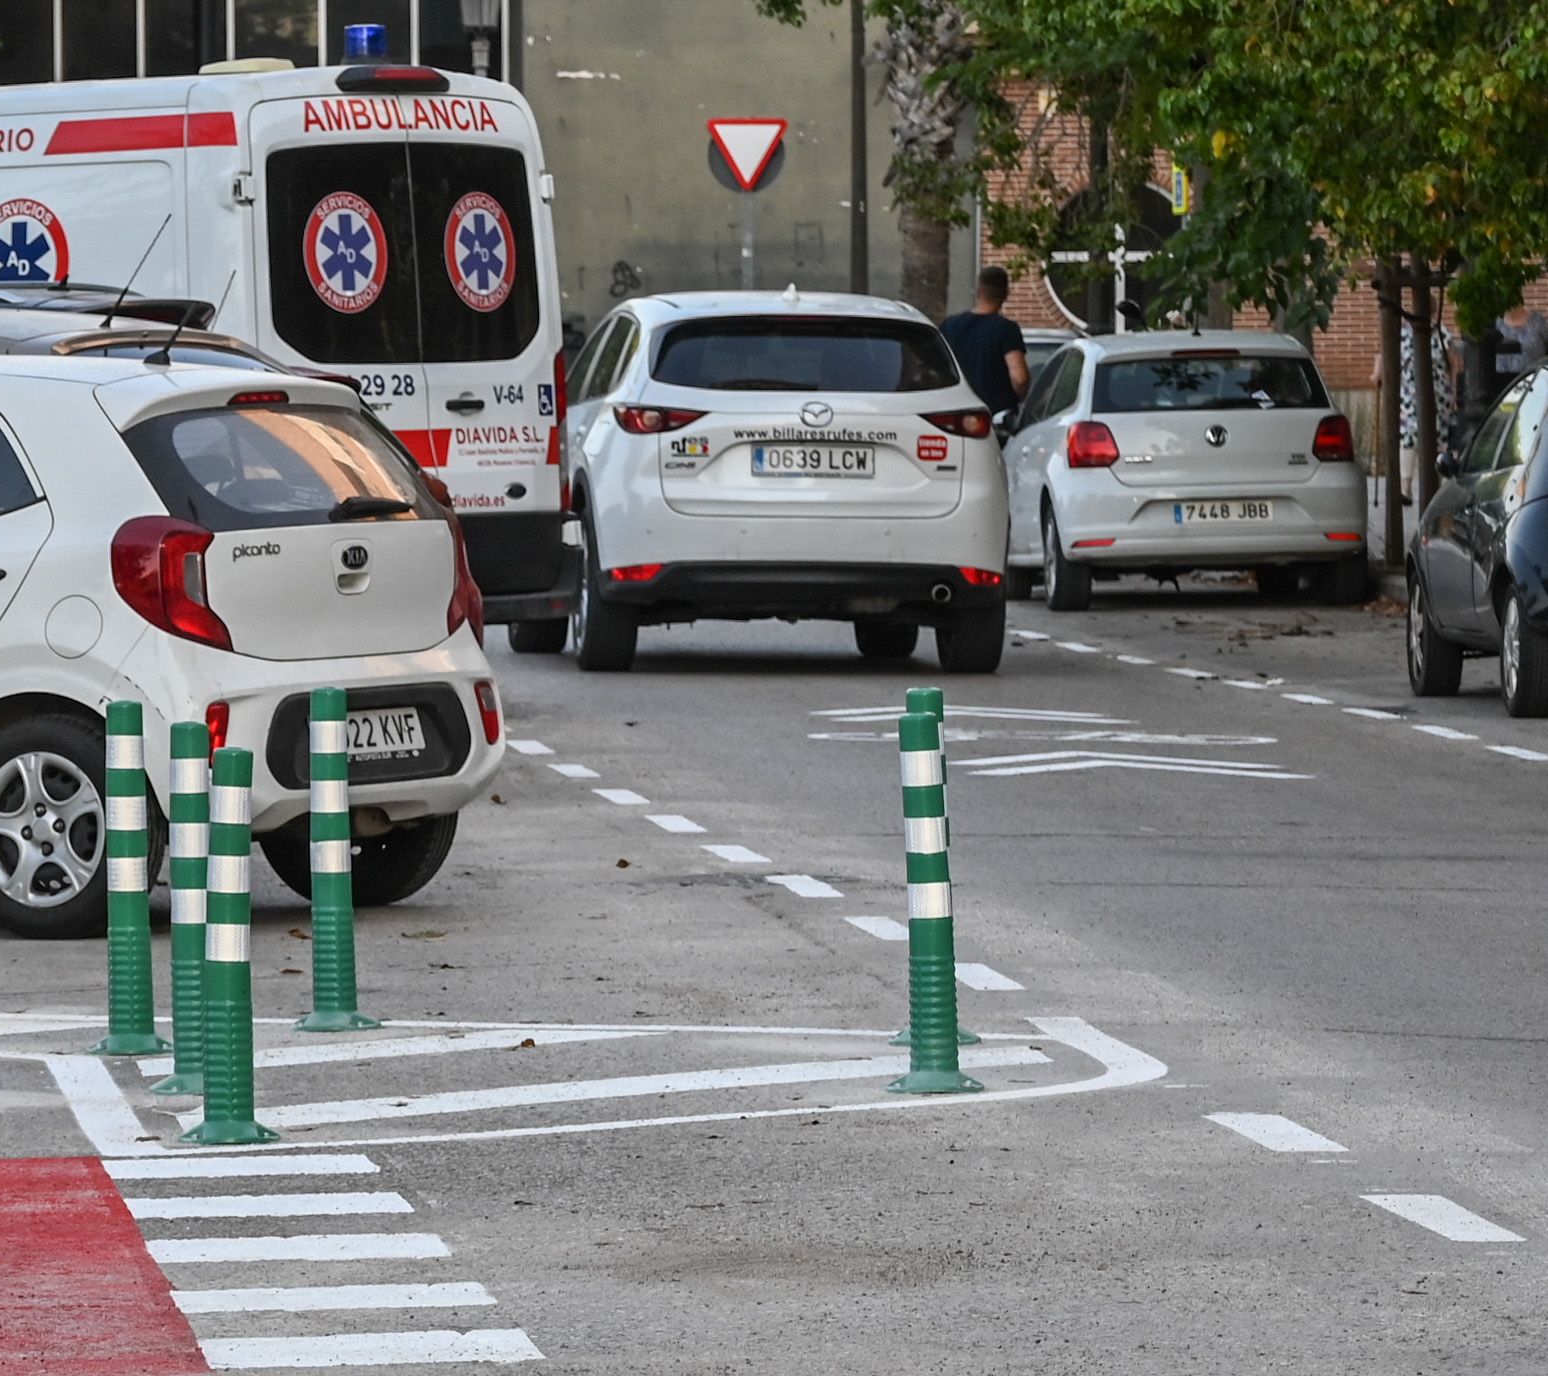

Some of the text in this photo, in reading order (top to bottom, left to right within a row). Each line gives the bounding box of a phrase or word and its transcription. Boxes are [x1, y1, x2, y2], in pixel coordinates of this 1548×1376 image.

[304, 99, 499, 132] AMBULANCIA
[317, 195, 370, 220] SERVICIOS
[455, 195, 501, 220] SERVICIOS
[7, 250, 30, 276] AD
[337, 240, 355, 263] AD
[317, 280, 378, 309] SANITARIOS
[457, 280, 509, 308] SANITARIOS
[361, 374, 415, 396] 29 28
[493, 384, 524, 404] V-64
[456, 427, 544, 445] DIAVIDA S.L.
[733, 427, 897, 442] www.billaresrufes.com
[768, 449, 867, 470] 0639 LCW
[1186, 503, 1270, 520] 7448 JBB
[232, 541, 281, 562] picanto
[347, 713, 415, 748] 22 KVF
